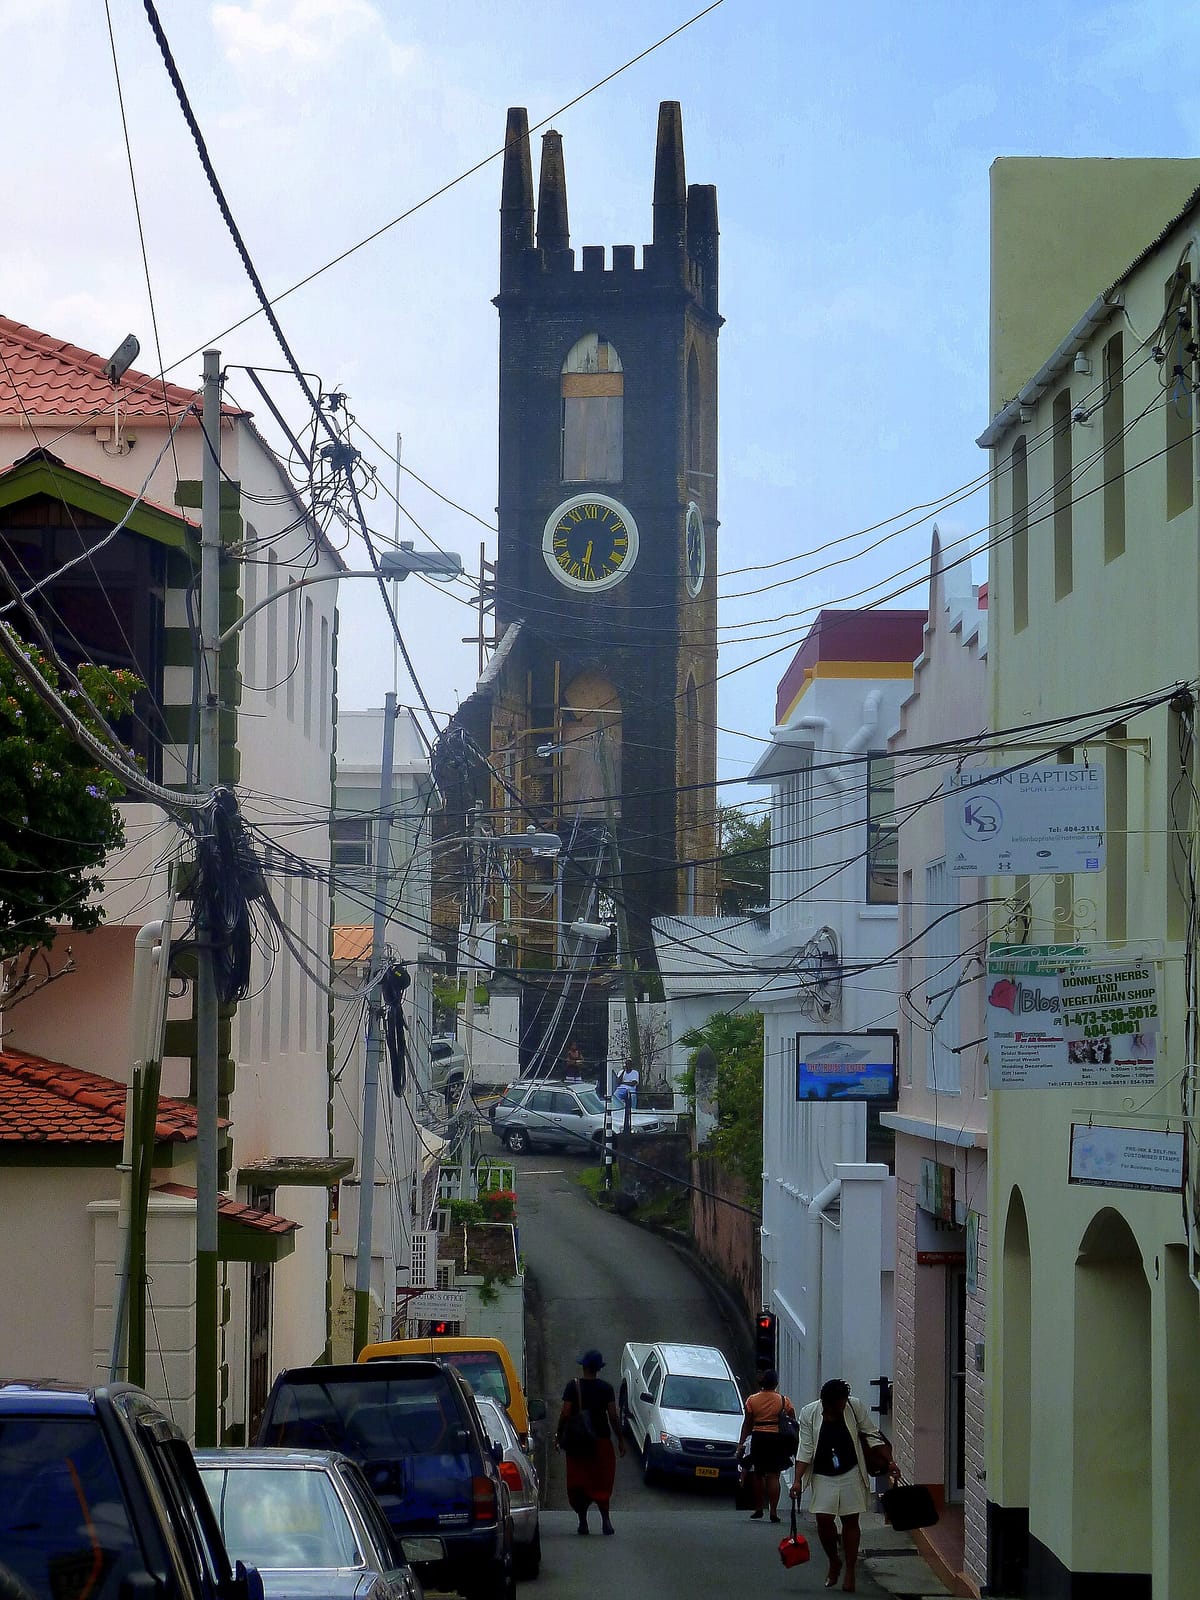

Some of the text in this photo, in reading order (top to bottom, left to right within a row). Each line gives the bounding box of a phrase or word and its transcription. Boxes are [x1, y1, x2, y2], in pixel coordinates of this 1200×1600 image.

[1019, 769, 1098, 784] BAPTISTE
[1062, 969, 1149, 988] DONNEL'S HERBS
[1096, 983, 1118, 994] AND
[1061, 988, 1156, 1007] VEGETARIAN SHOP
